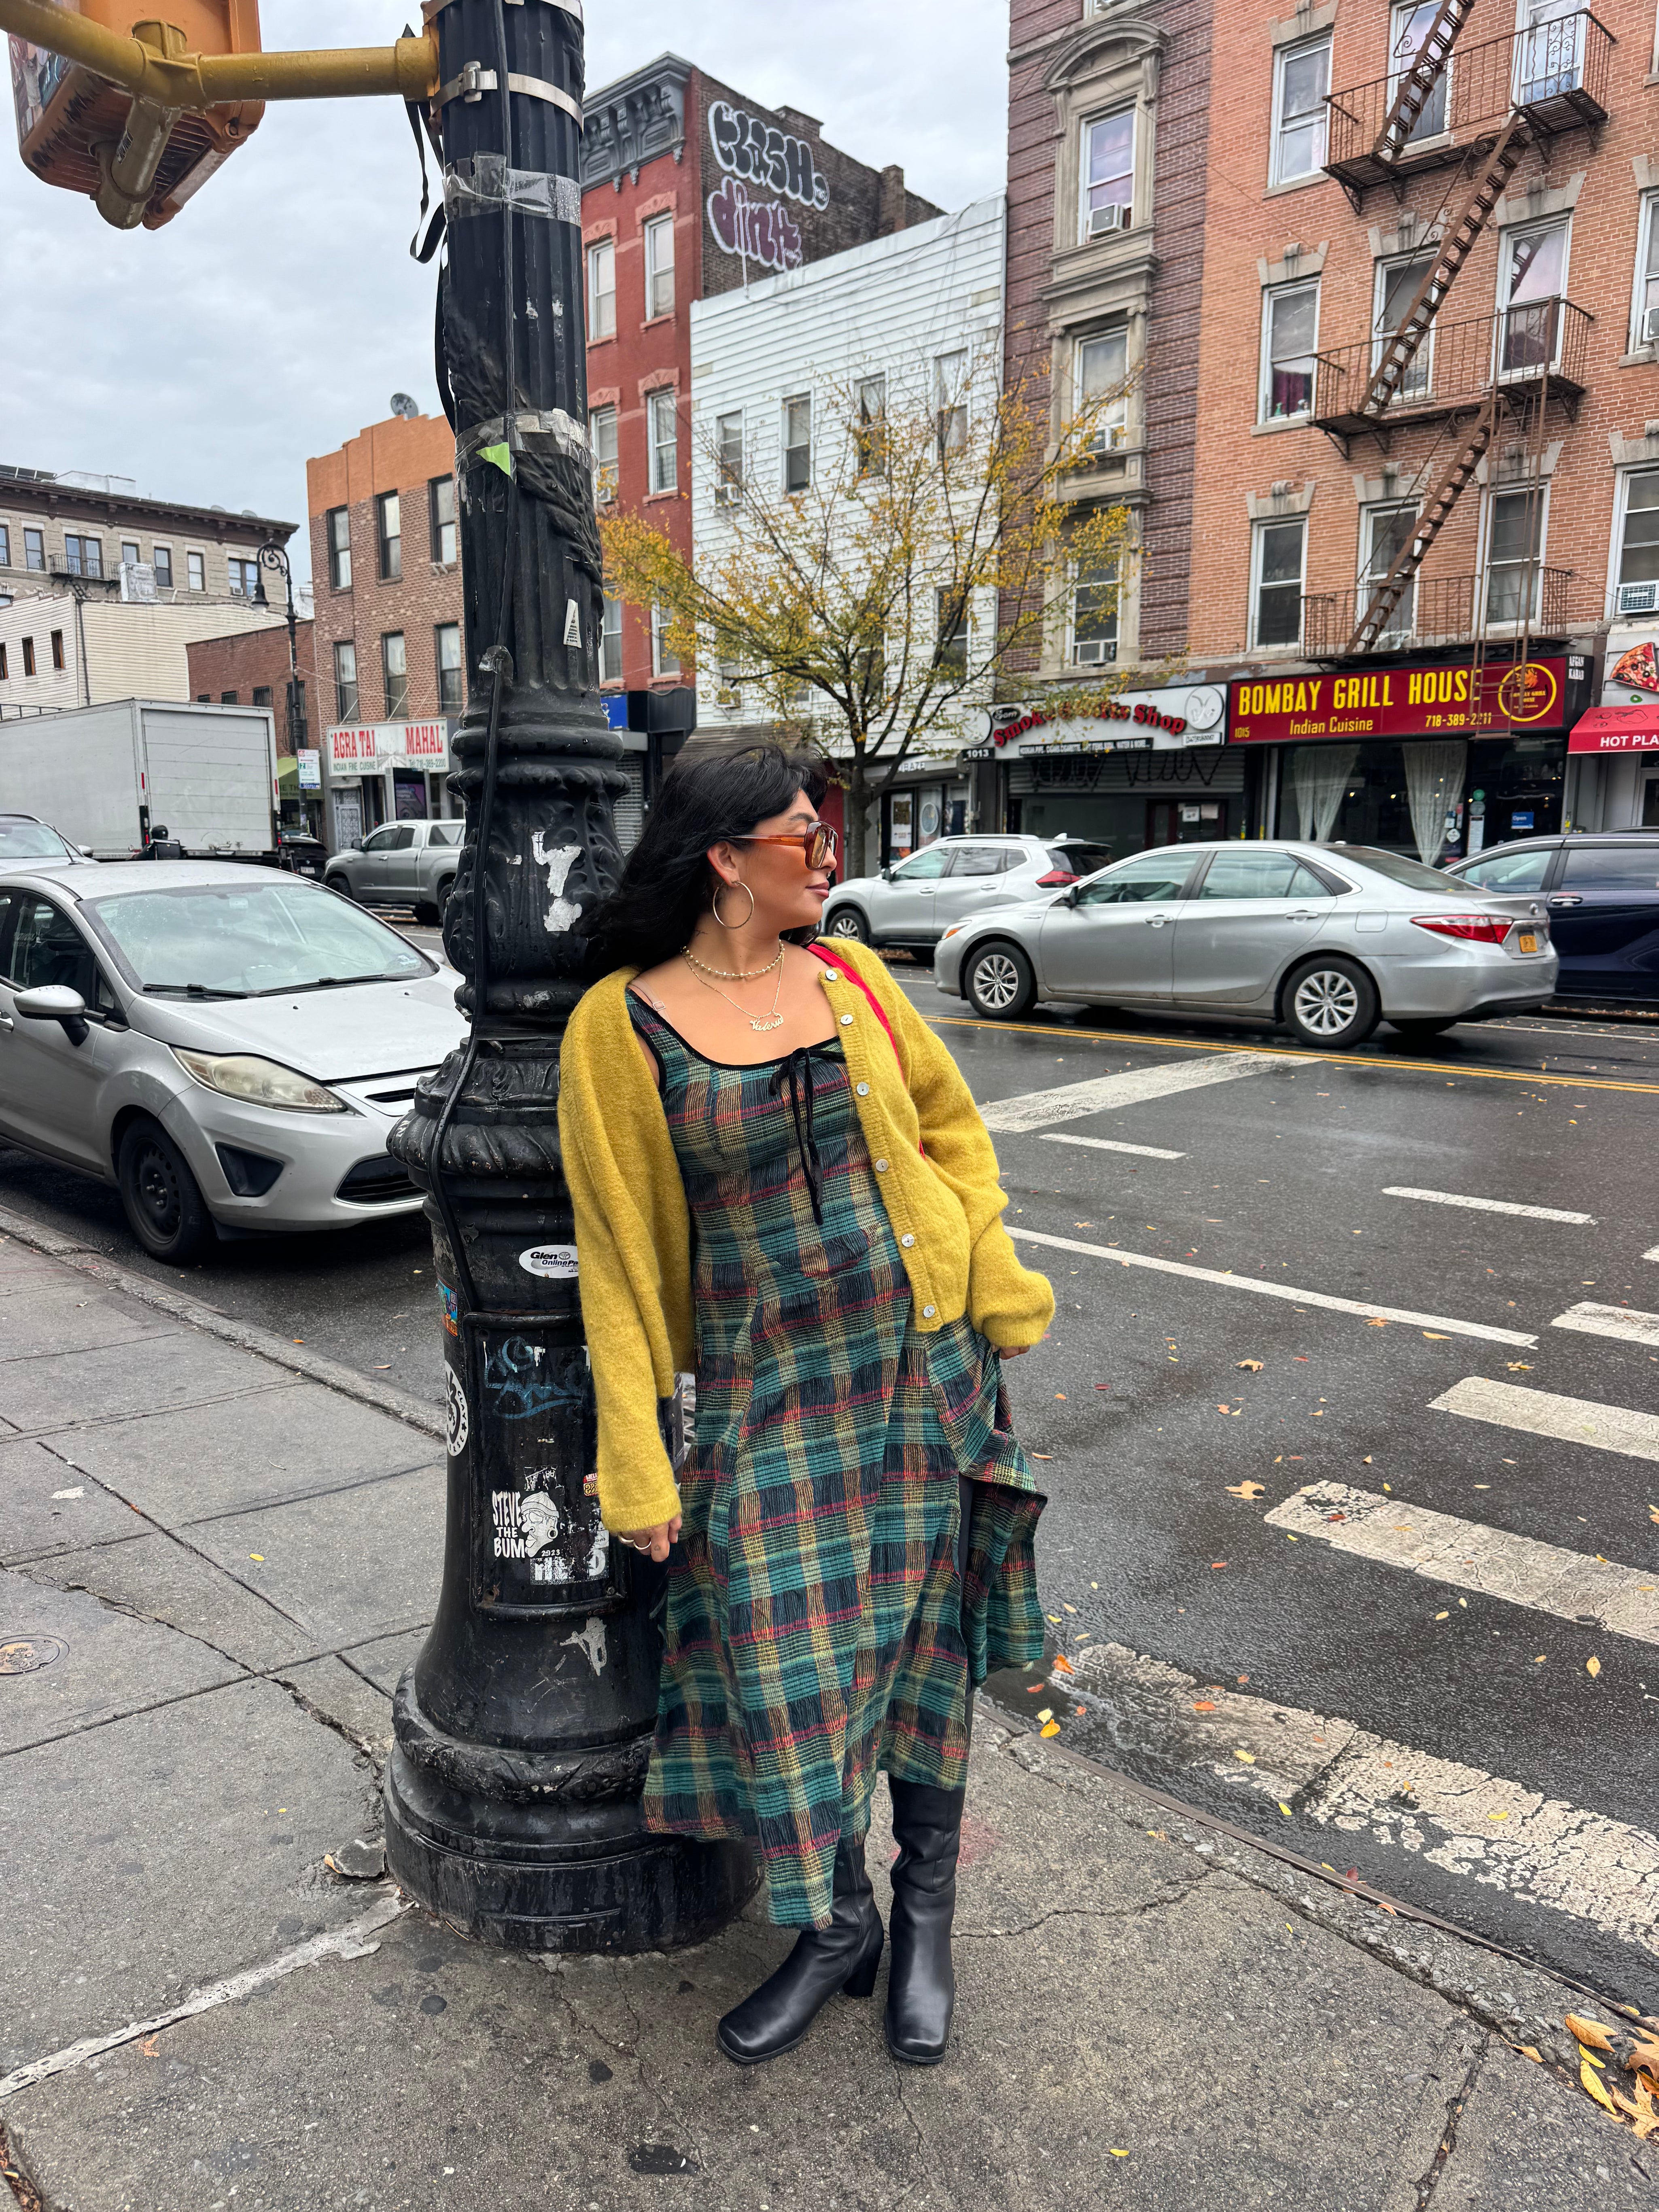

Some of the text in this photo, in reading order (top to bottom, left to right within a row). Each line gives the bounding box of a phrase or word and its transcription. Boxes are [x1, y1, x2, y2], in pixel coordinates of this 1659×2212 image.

[1239, 680, 1322, 716] BOMBAY
[1333, 675, 1394, 709] GRILL
[1408, 669, 1483, 705] HOUSE
[1133, 704, 1186, 735] Shop
[1290, 716, 1373, 735] Indian Cuisine
[334, 732, 358, 759] AGRA
[405, 724, 443, 755] MAHAL
[1234, 726, 1250, 739] 1015
[1600, 734, 1659, 747] HOT PLA
[966, 749, 989, 758] 1013
[749, 1013, 783, 1031] Valeria
[530, 1251, 558, 1259] Glen
[492, 1490, 522, 1527] STEVE
[496, 1526, 518, 1538] THE
[494, 1537, 525, 1558] BUM
